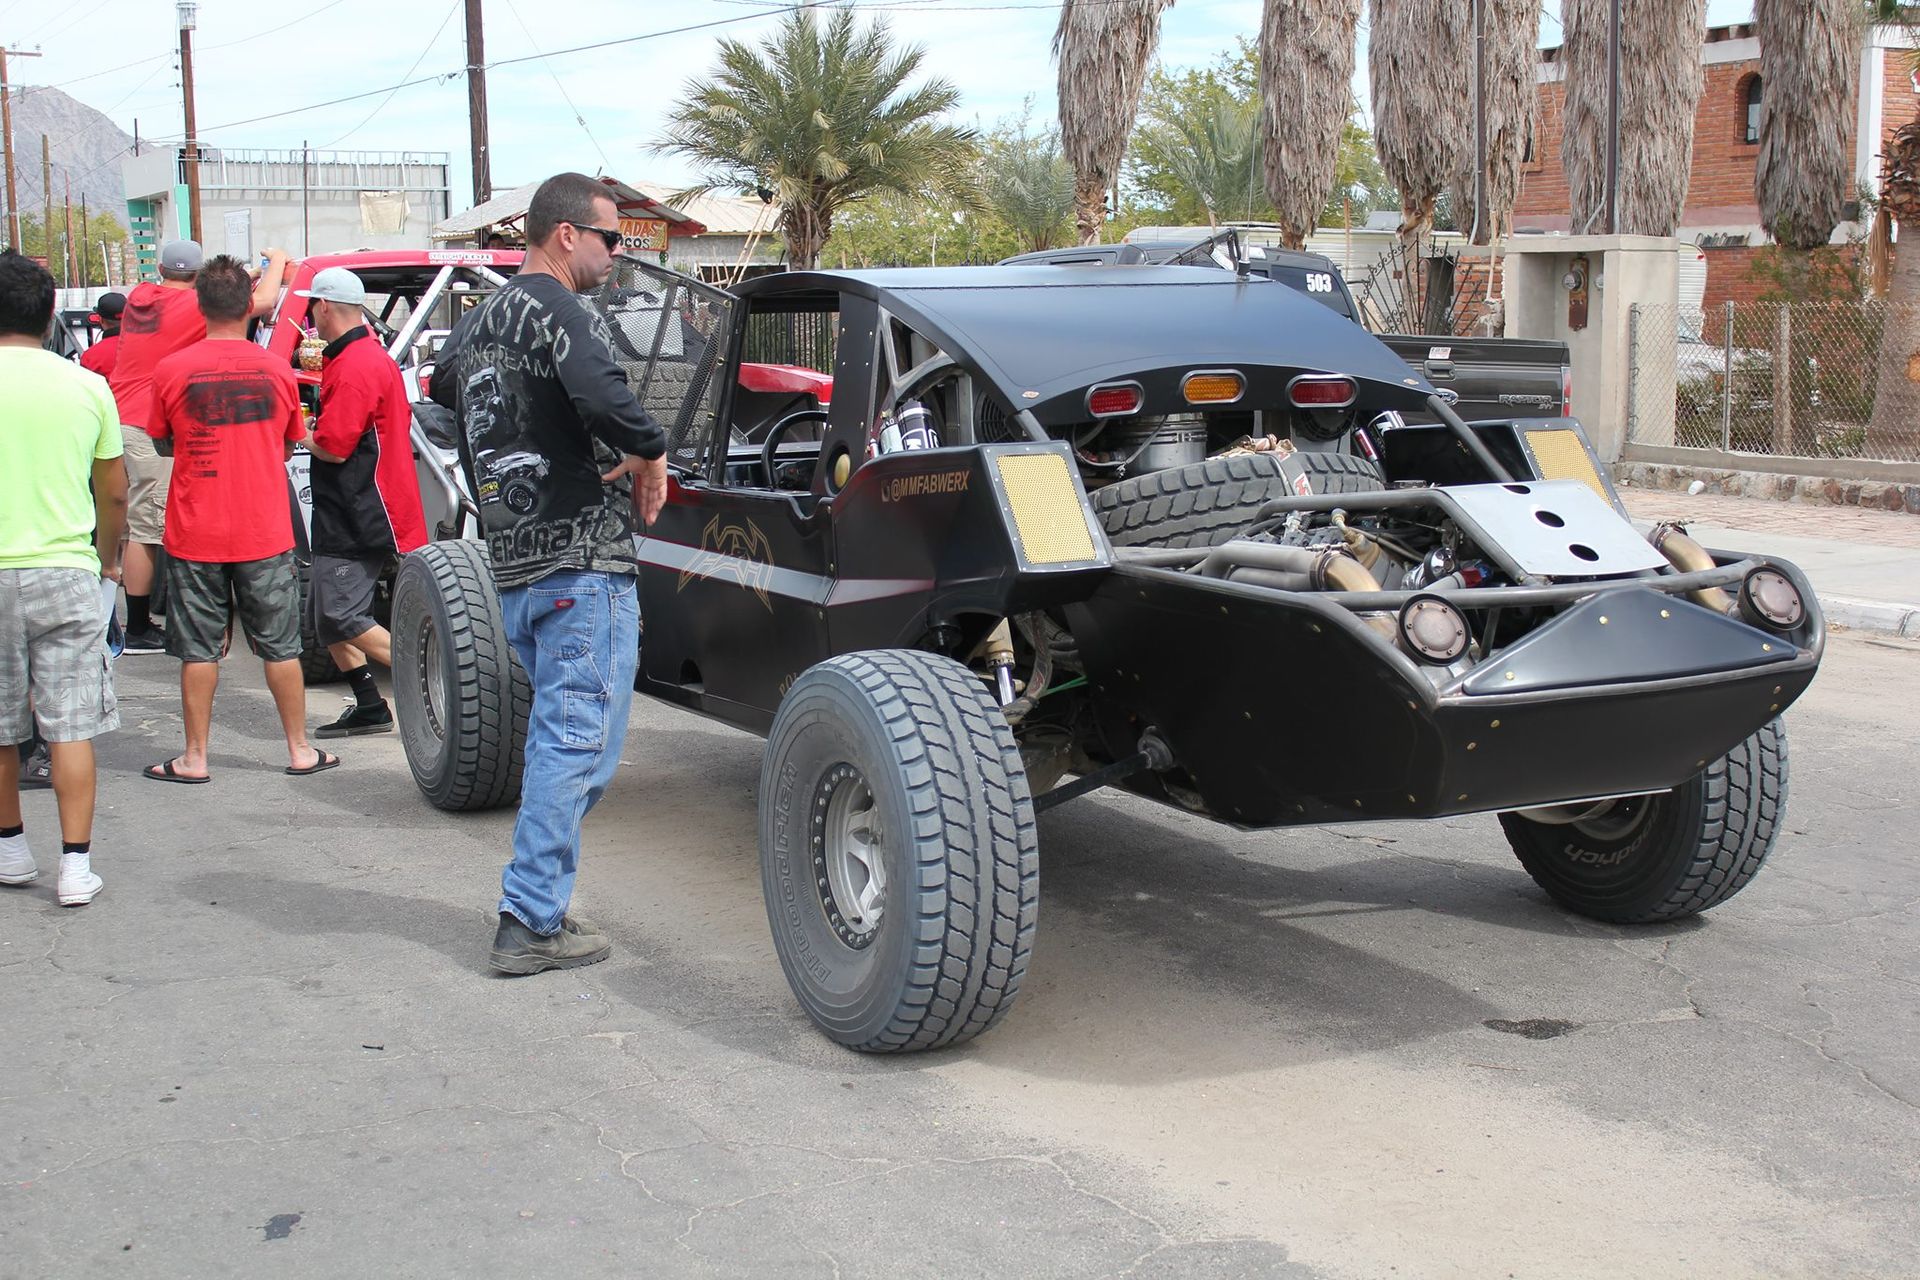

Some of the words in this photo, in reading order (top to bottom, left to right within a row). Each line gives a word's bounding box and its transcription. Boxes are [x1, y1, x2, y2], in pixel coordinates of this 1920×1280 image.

[1306, 273, 1333, 293] 503
[1499, 394, 1552, 407] RAPTOR
[891, 471, 970, 502] @MMFABWERX
